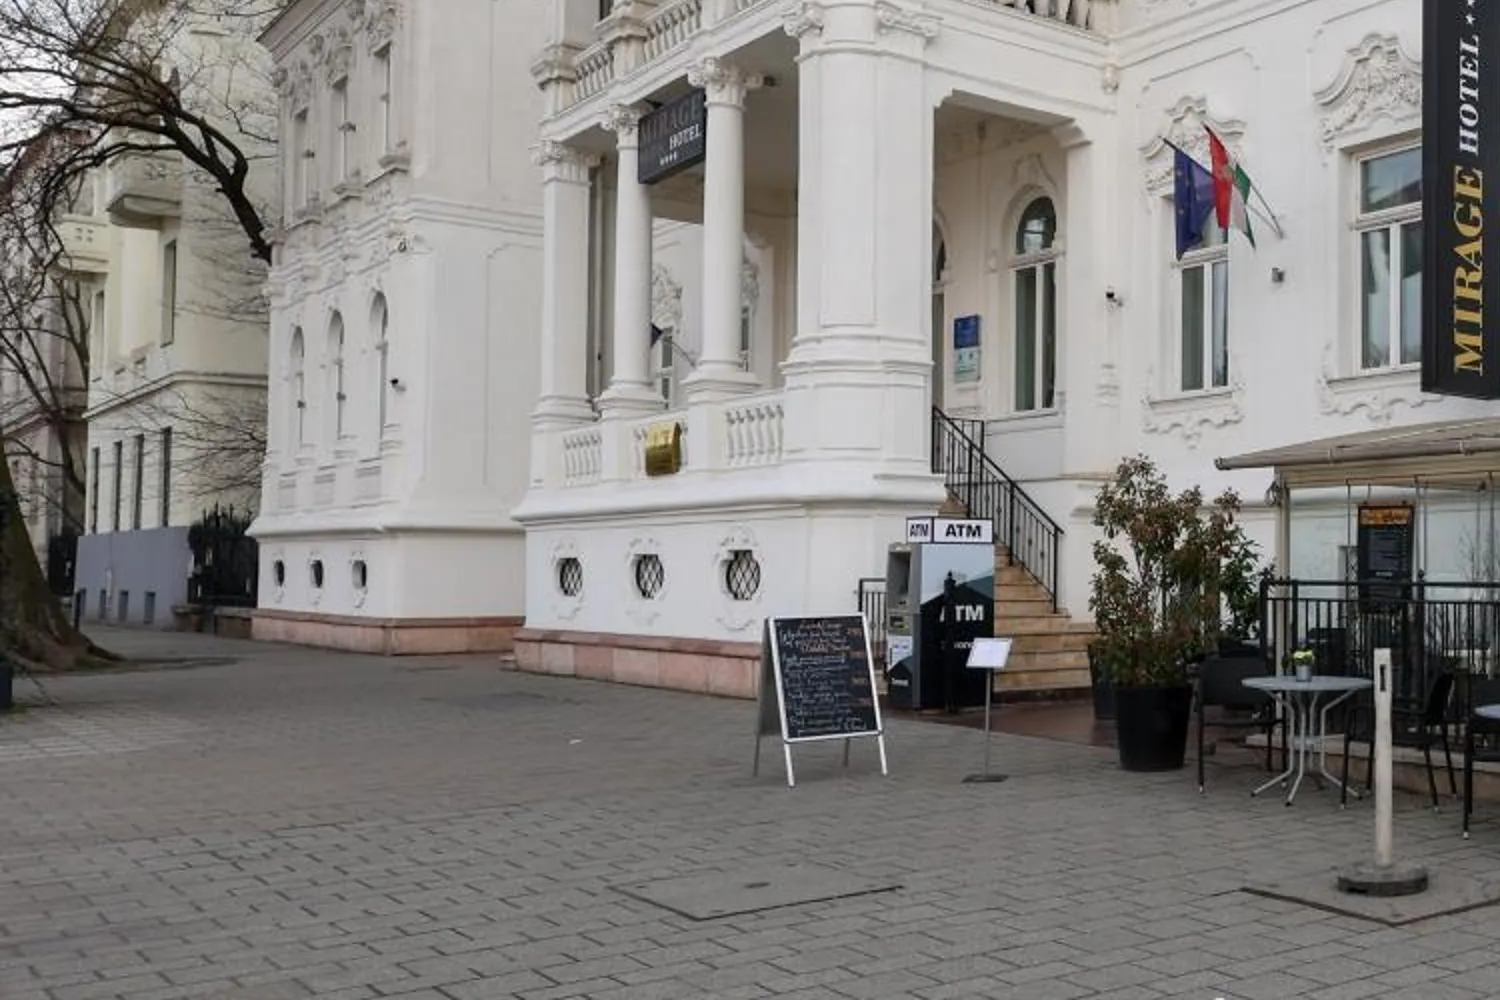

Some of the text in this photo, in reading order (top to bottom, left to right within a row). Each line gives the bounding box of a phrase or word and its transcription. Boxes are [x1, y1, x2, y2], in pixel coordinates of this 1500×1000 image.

[669, 123, 701, 151] HOTEL
[1453, 34, 1484, 377] MIRAGE HOTEL
[909, 523, 929, 537] ATM
[945, 523, 982, 538] ATM
